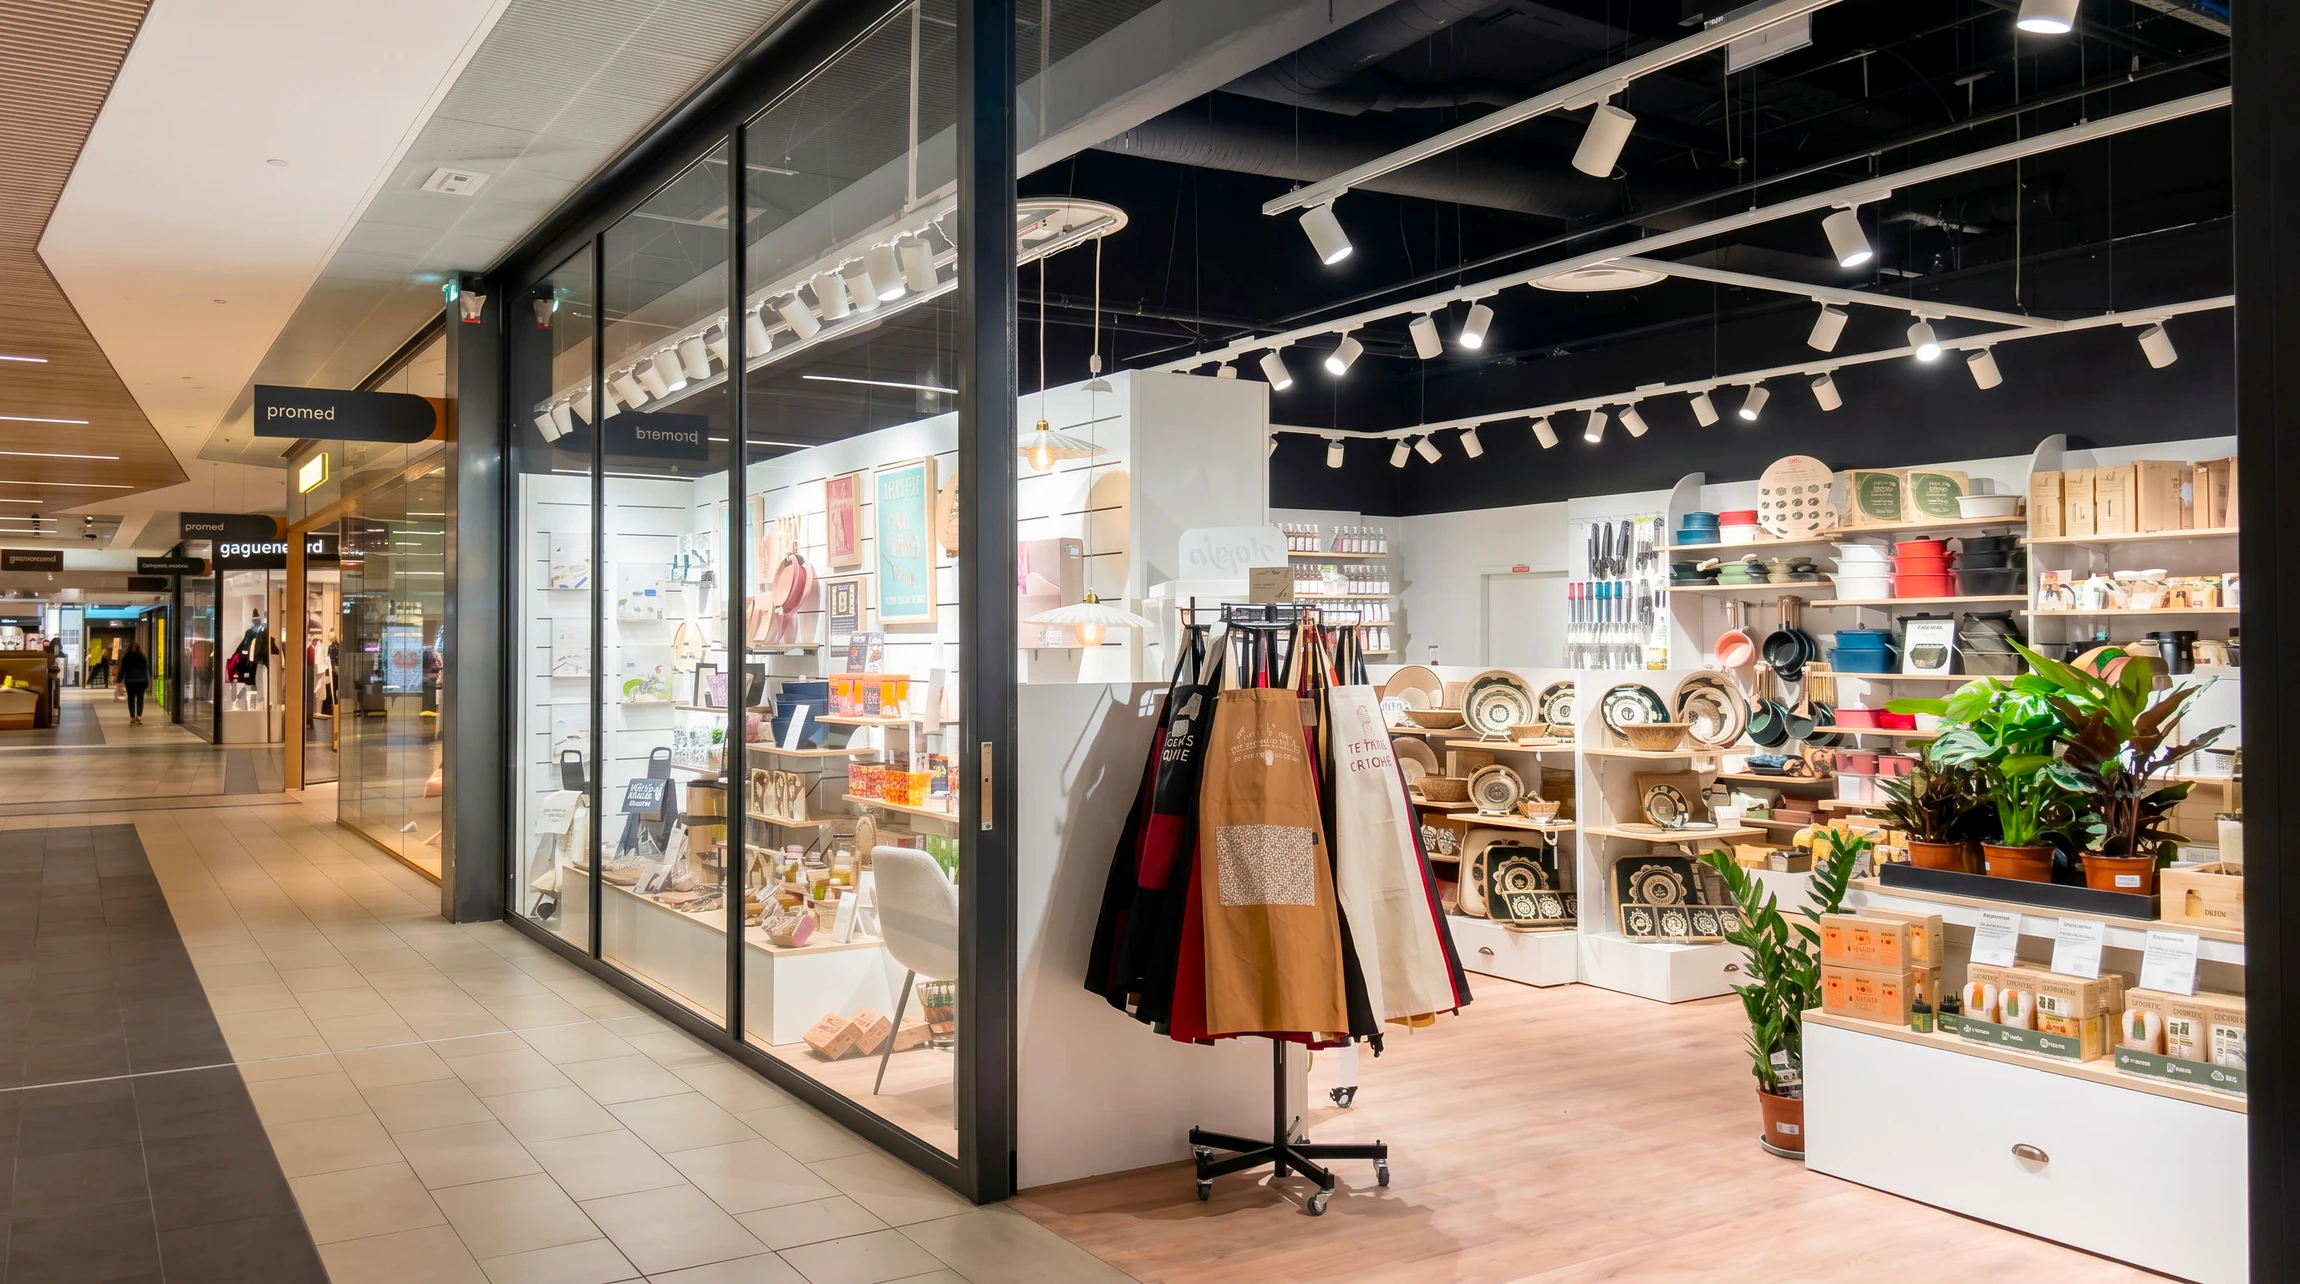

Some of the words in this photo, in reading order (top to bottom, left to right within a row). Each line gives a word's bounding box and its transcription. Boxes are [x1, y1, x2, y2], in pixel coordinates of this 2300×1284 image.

[267, 406, 335, 421] promed
[185, 522, 224, 532] promed
[1348, 742, 1361, 755] TE
